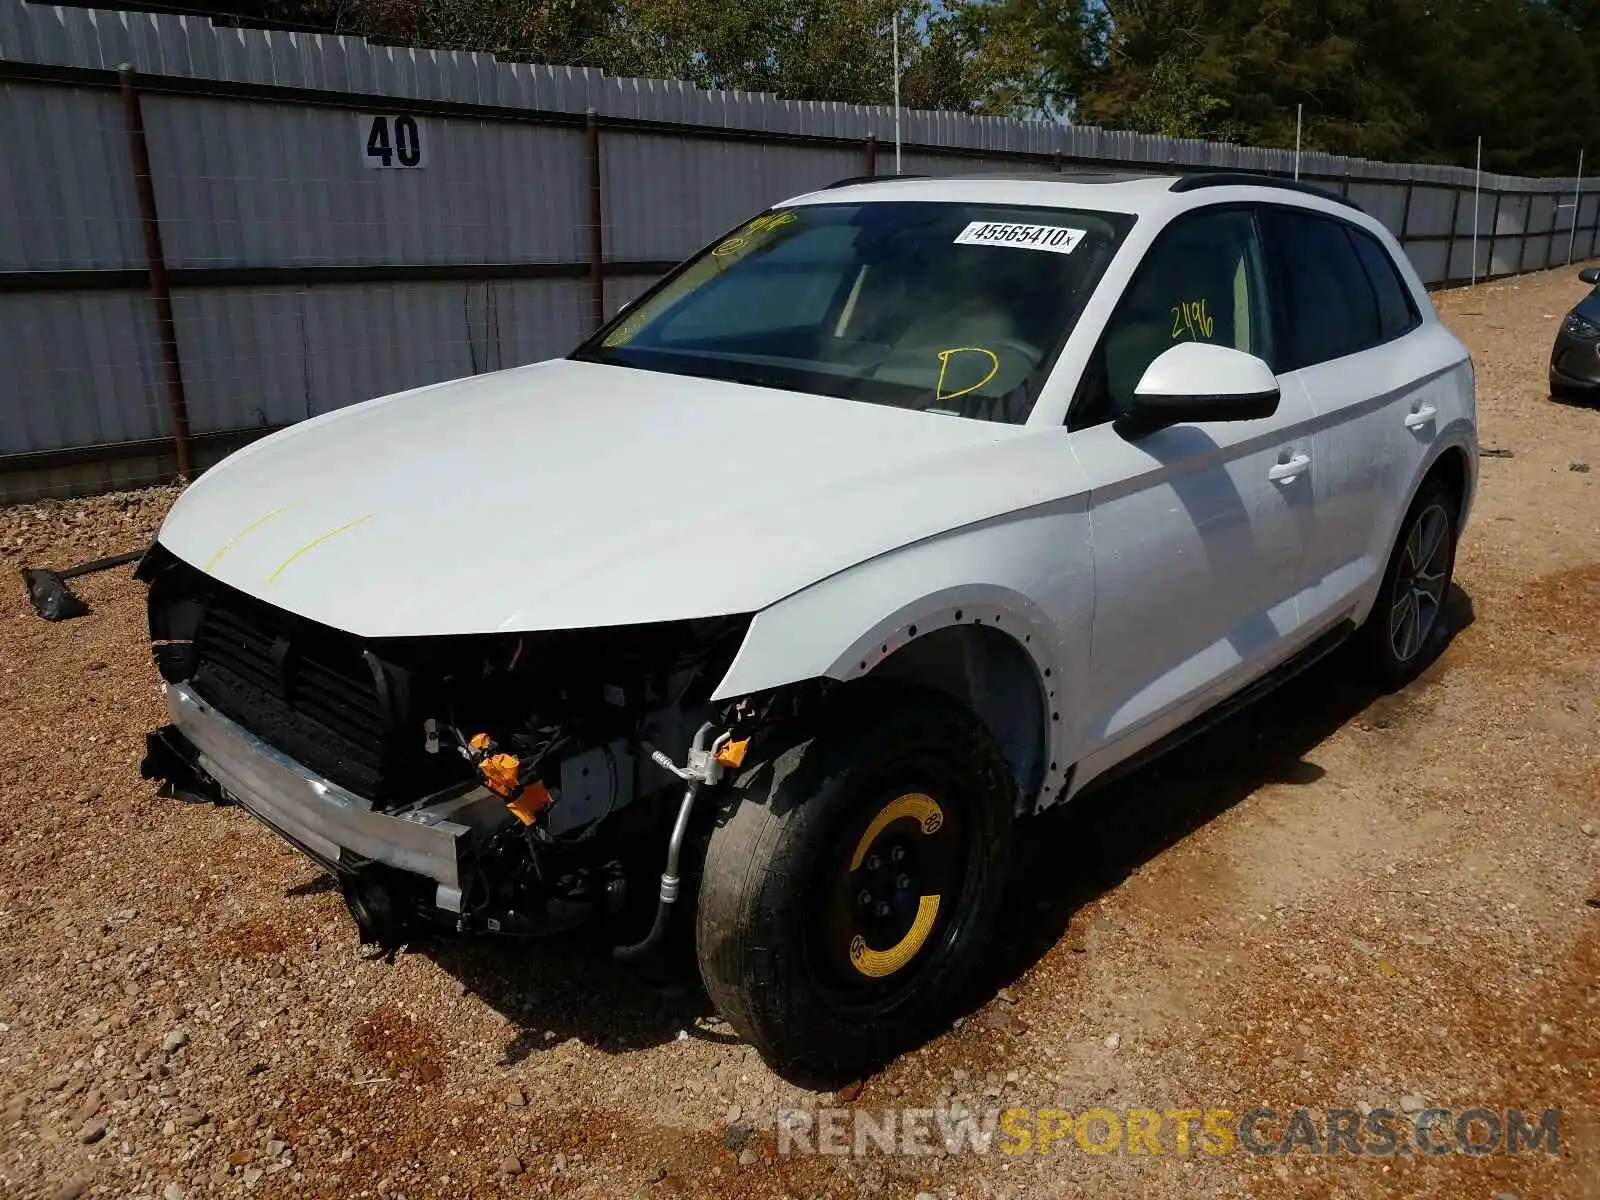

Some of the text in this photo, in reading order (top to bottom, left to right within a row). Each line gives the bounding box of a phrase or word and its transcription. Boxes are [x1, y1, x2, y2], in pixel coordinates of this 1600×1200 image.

[367, 116, 420, 167] 40
[936, 347, 999, 401] D
[924, 812, 941, 833] 80
